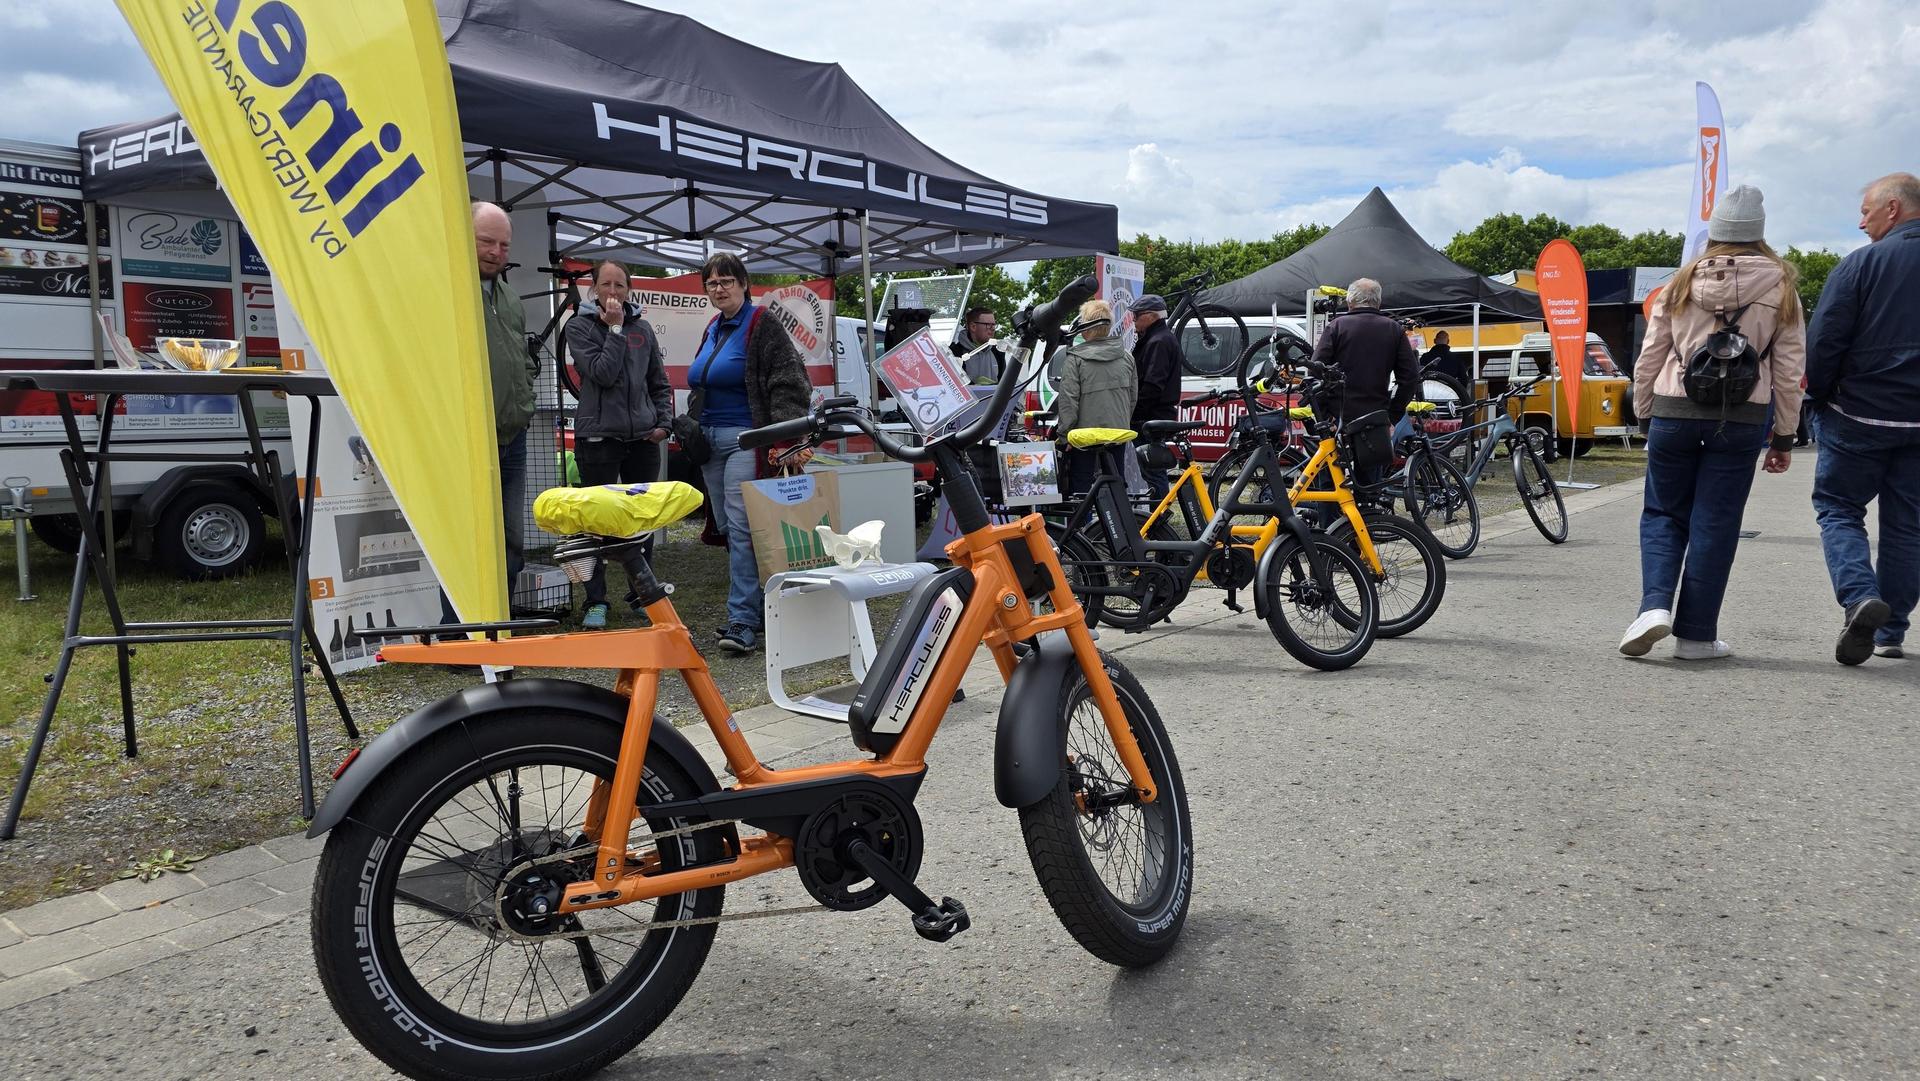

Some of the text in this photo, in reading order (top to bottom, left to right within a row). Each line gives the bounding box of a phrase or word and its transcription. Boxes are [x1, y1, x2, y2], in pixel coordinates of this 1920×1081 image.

[89, 118, 202, 176] HERC
[593, 101, 1048, 225] HERCULES
[128, 212, 190, 251] Bade
[161, 244, 202, 253] Ambulanter
[157, 297, 203, 306] AutoTec
[631, 291, 709, 308] NNENBERG
[769, 300, 817, 351] FAHRRAD
[290, 352, 299, 368] 1
[931, 357, 964, 403] DANNENBERG
[1201, 406, 1225, 426] VON
[788, 478, 807, 486] stecken
[317, 580, 328, 597] 3
[889, 605, 952, 722] HERCULES
[1137, 843, 1190, 933] SUPER MOTO-X
[354, 835, 443, 1052] SUPER MOTO-X
